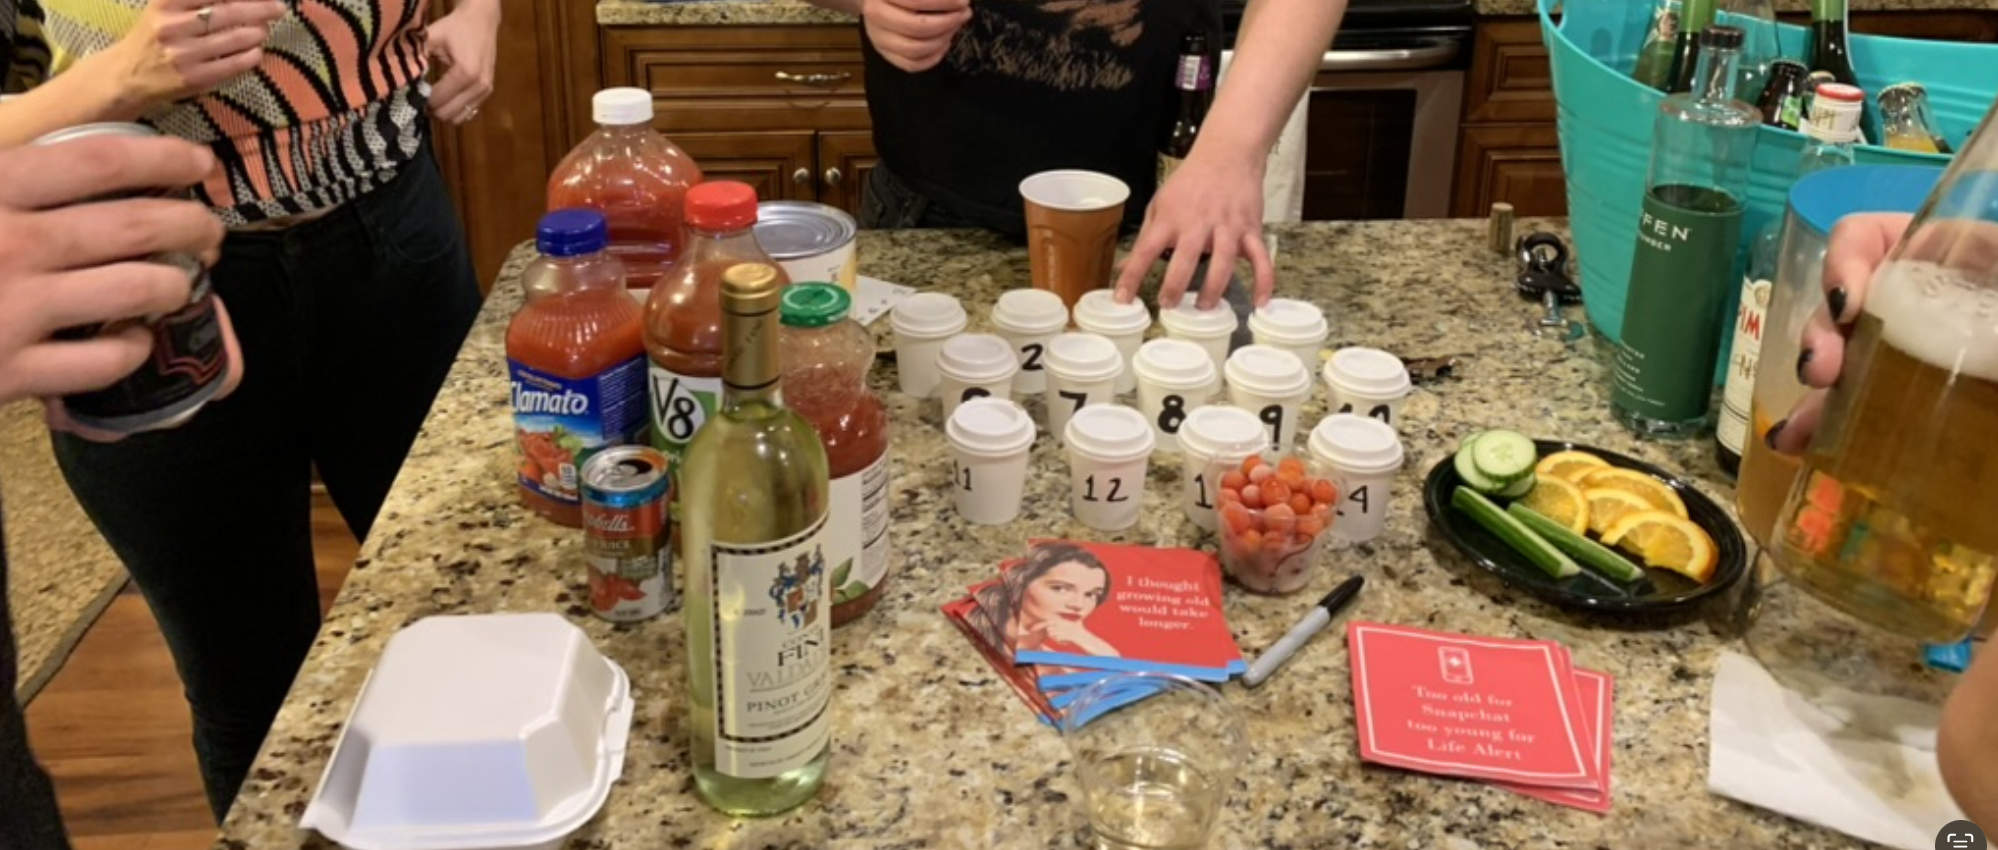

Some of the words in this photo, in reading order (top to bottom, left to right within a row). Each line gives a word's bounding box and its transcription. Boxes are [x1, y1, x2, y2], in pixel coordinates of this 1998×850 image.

[1640, 210, 1690, 241] FEN
[1021, 343, 1044, 370] 2
[653, 375, 696, 440] V8
[1058, 389, 1088, 414] 7
[1158, 394, 1186, 434] 8
[1259, 404, 1283, 451] 9
[1082, 474, 1129, 502] 12
[1194, 473, 1213, 509] 1
[1127, 575, 1133, 587] I
[1138, 576, 1199, 592] thought
[1117, 591, 1181, 606] growing
[1185, 595, 1210, 606] old
[1119, 604, 1167, 616] would
[1172, 607, 1208, 618] take
[1138, 616, 1195, 631] longer.
[746, 690, 799, 713] PINOT
[1411, 685, 1448, 701] Too
[1452, 692, 1481, 704] old
[1487, 694, 1512, 707] for
[1421, 703, 1511, 723] Snapchat
[1407, 719, 1438, 732] too
[1443, 726, 1502, 743] young
[1508, 729, 1535, 743] for
[1427, 738, 1466, 753] Life
[1474, 743, 1522, 760] Alert
